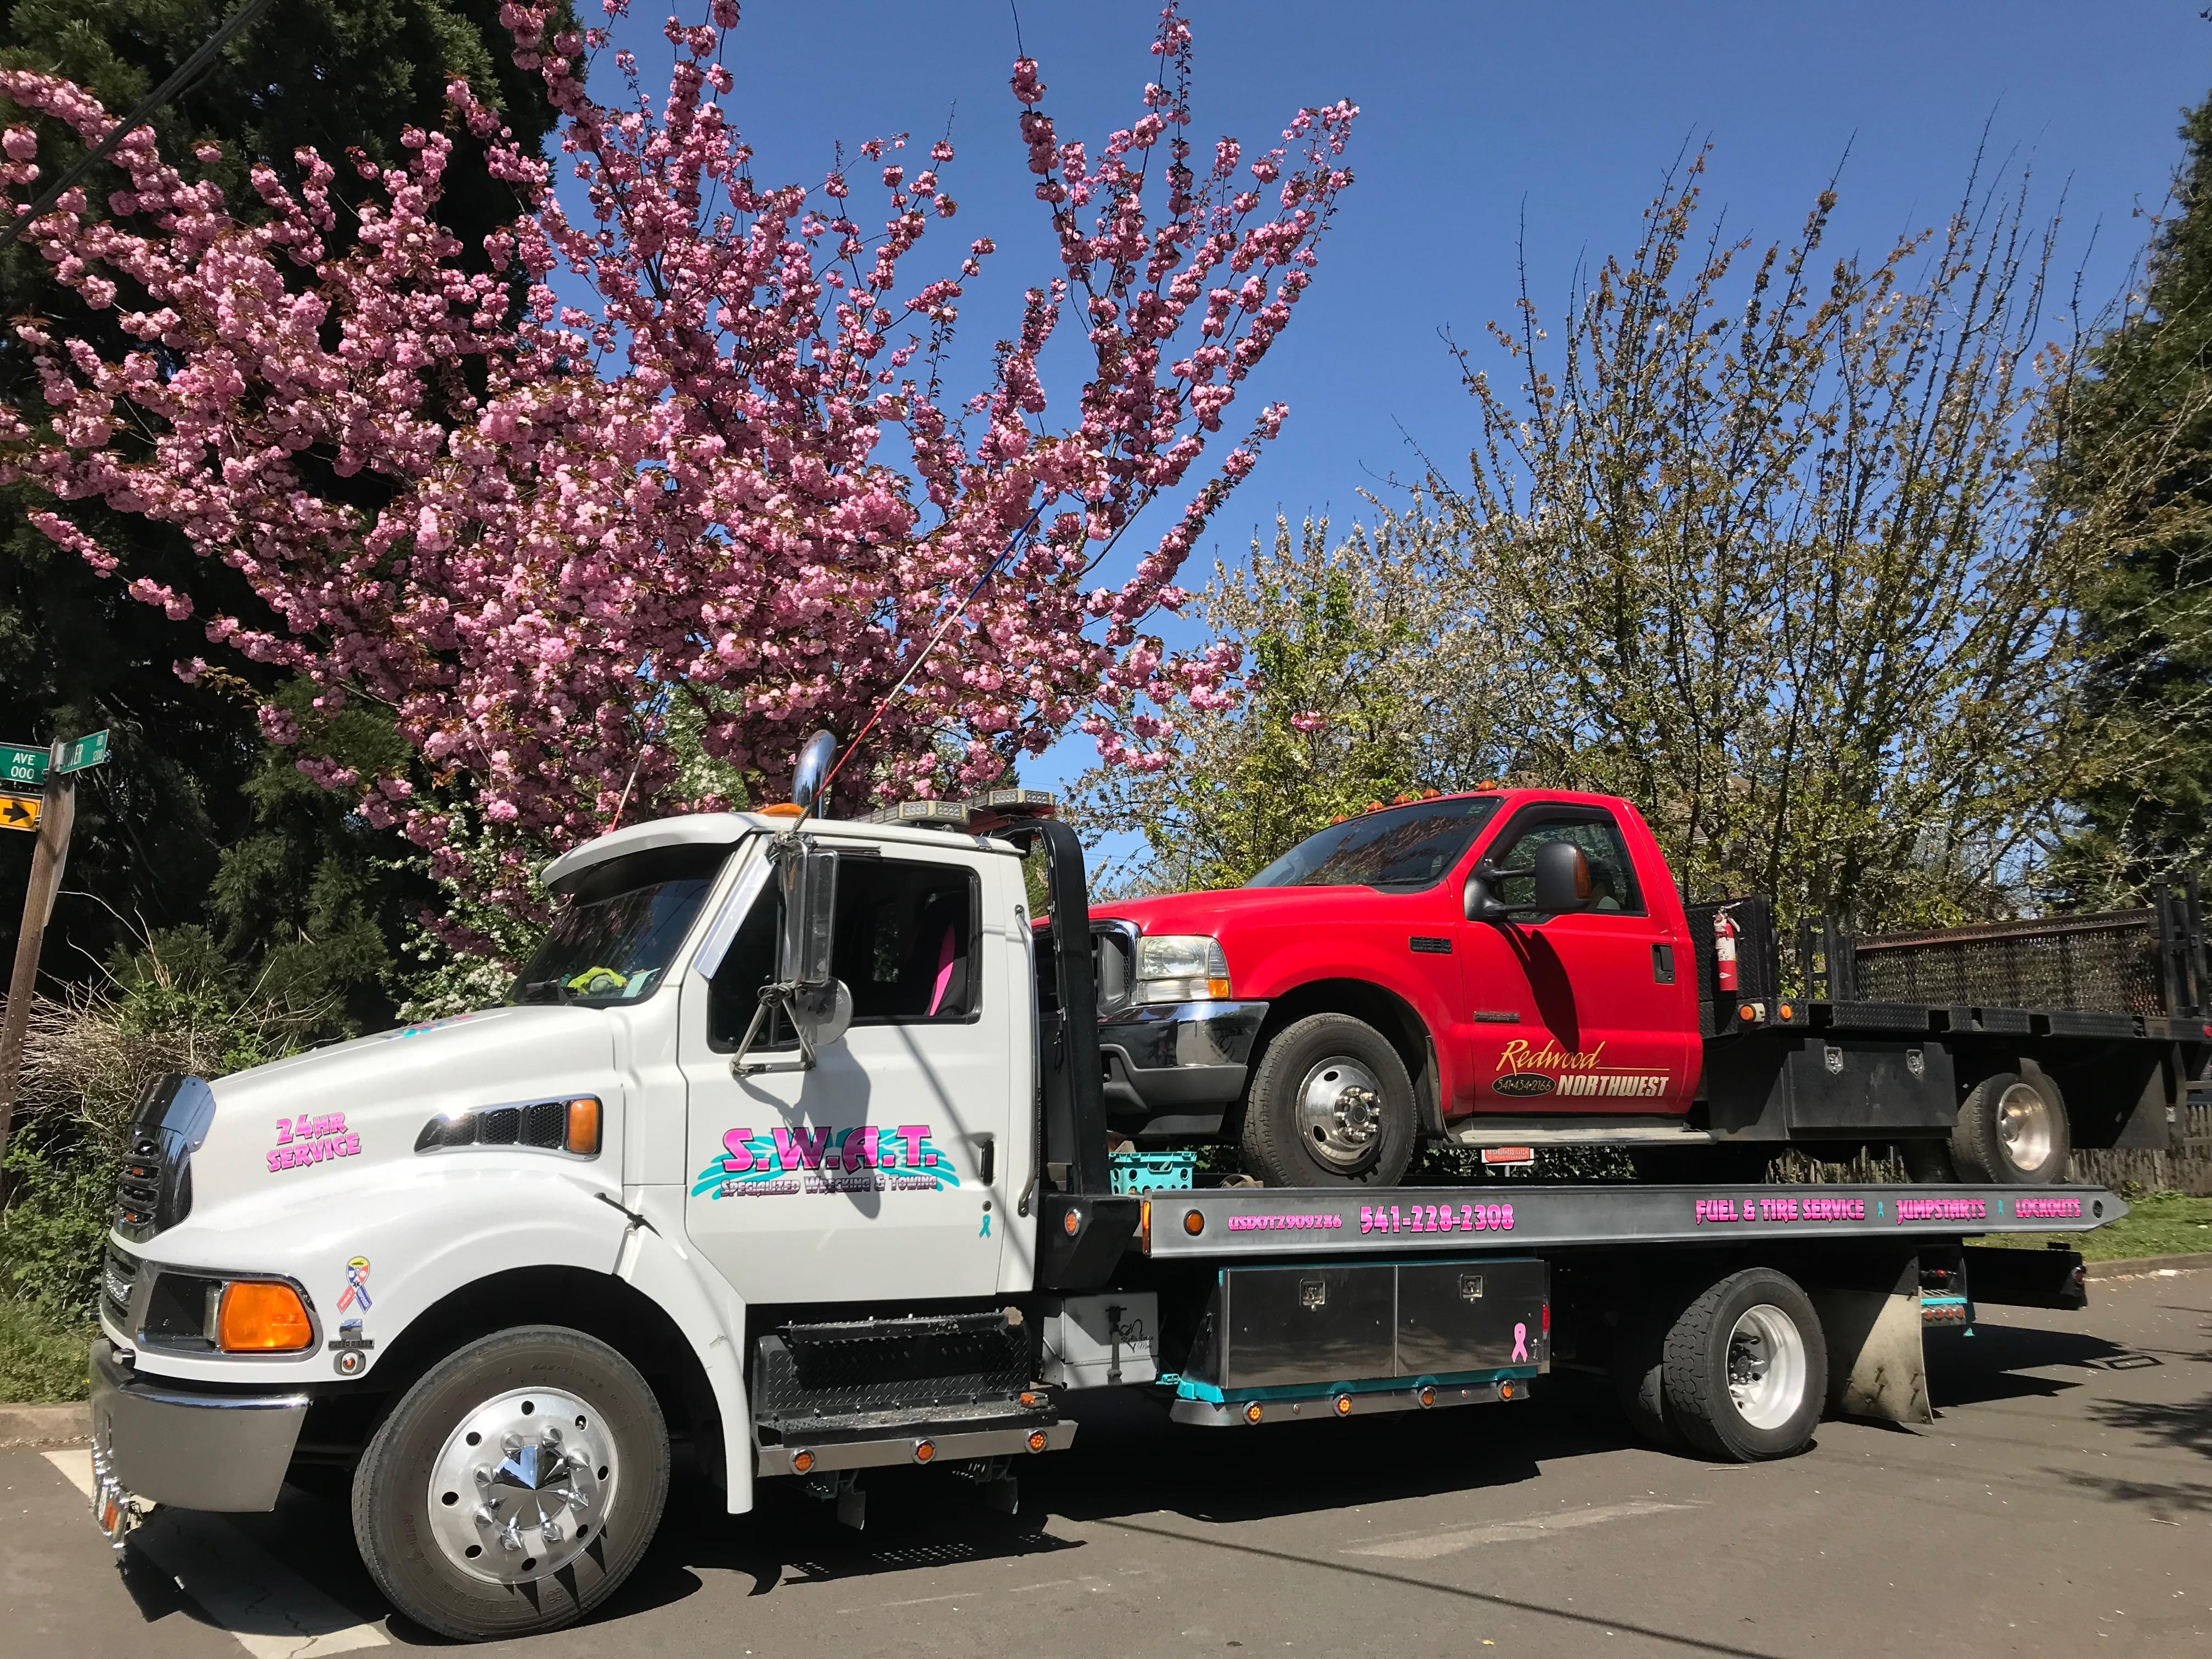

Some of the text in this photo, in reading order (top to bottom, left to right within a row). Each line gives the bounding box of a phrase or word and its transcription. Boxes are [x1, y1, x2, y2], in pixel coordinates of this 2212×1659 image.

[13, 752, 36, 766] AVE
[10, 766, 35, 780] 000
[1496, 1039, 1605, 1076] Redwood
[1556, 1074, 1669, 1097] NORTHWEST
[266, 1132, 362, 1173] SERVICE
[722, 1125, 938, 1175] S.W.A.T.
[874, 1173, 885, 1192] &
[889, 1173, 938, 1192] TOWING
[1360, 1203, 1515, 1234] 541-228-2308
[1696, 1199, 1865, 1225] FUEL & TIRE SERVICE
[1896, 1199, 1987, 1225] JUMPSTARTS
[2015, 1198, 2082, 1218] LOCKOUTS
